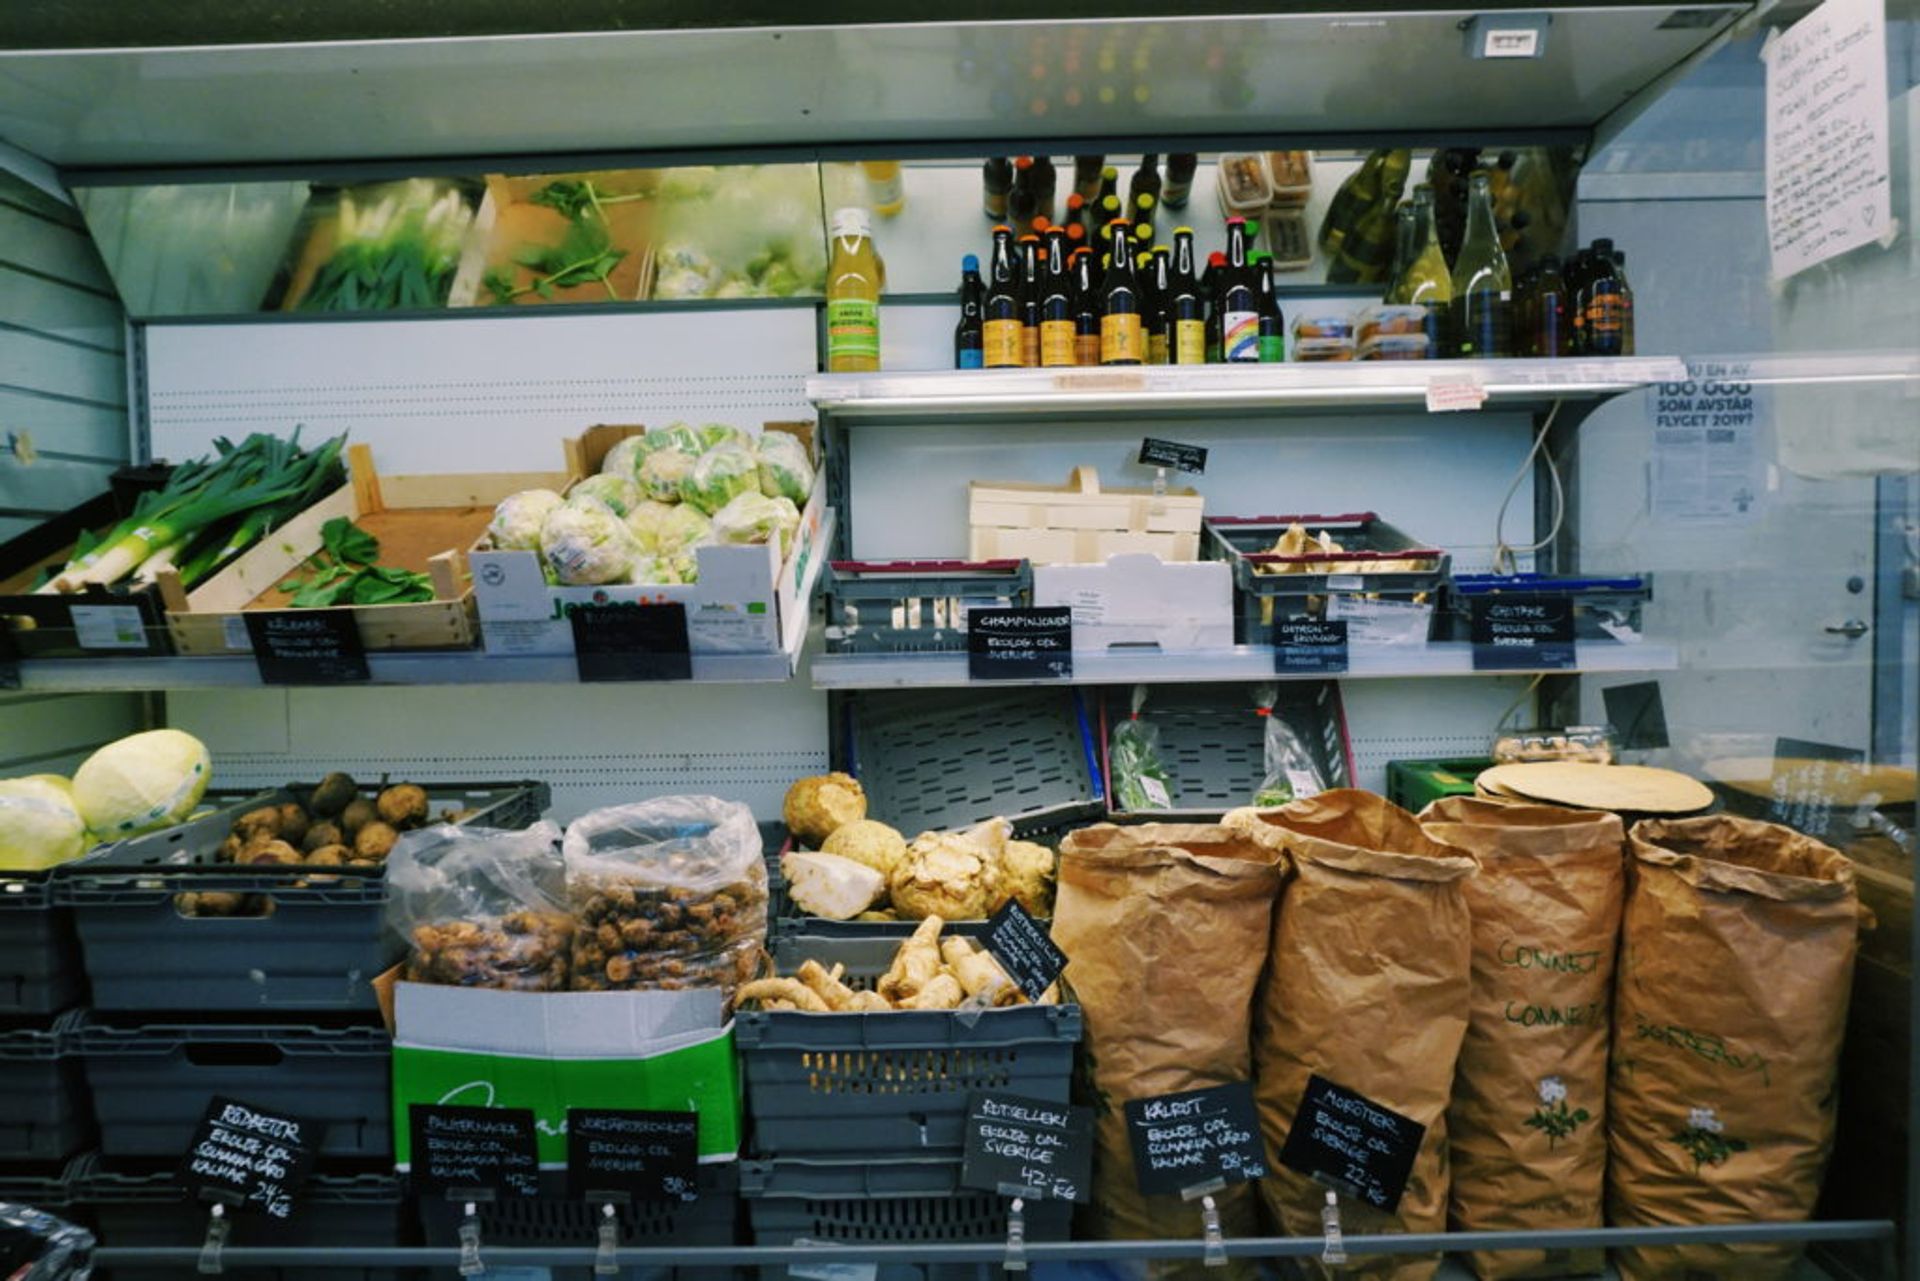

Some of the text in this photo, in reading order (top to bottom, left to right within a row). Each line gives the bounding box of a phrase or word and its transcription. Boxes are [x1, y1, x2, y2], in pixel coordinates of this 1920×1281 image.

[1706, 364, 1726, 377] EN
[1659, 381, 1697, 396] 100
[1658, 397, 1753, 412] SOM AVSTÅR
[1656, 413, 1753, 427] FLYGET 2019?
[982, 1099, 1069, 1128] ROTSELLERI
[984, 1139, 1054, 1164] SVERIGE
[1151, 1152, 1205, 1170] KALMAR
[1052, 1184, 1077, 1200] KG
